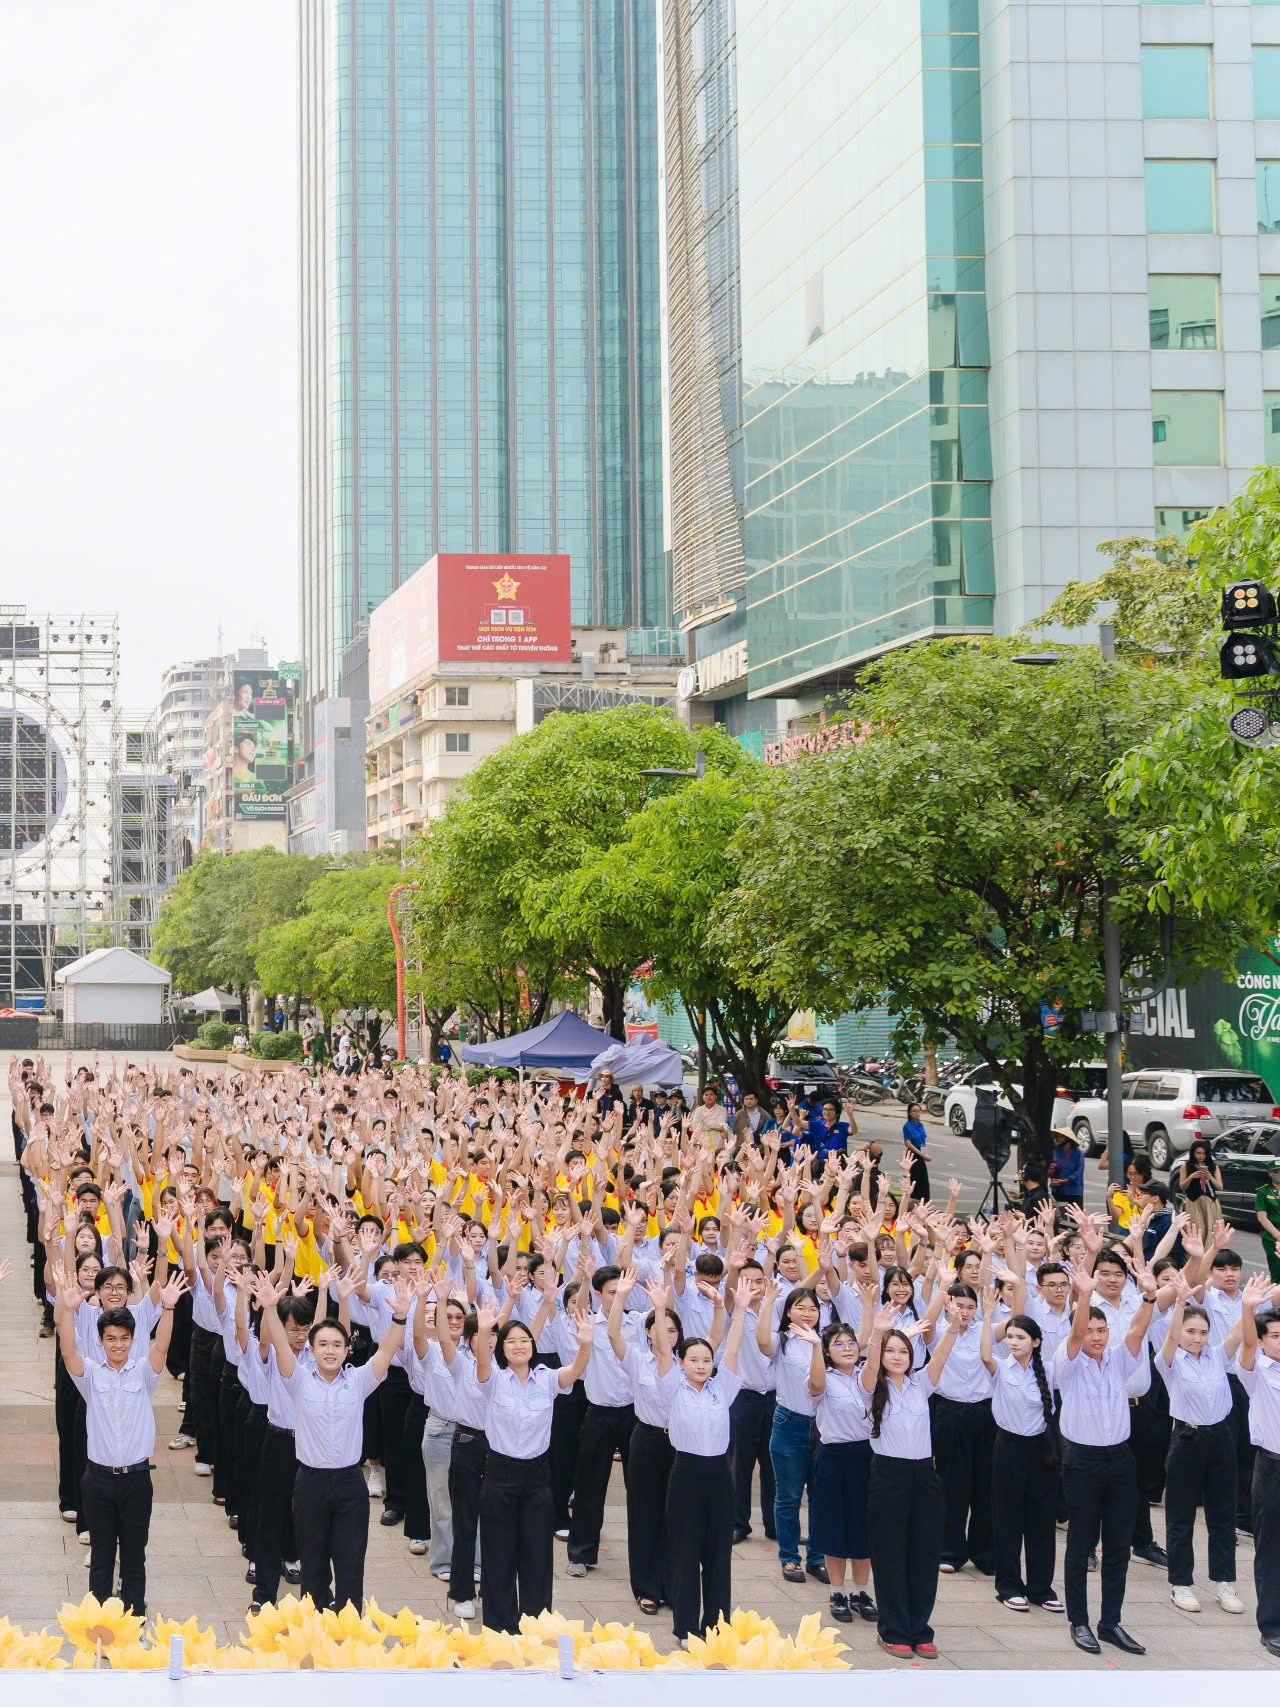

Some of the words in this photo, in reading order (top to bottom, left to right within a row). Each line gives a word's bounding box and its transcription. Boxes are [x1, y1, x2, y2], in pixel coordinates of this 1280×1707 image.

[477, 634, 490, 643] CHỈ
[242, 792, 260, 802] ĐẤU
[261, 793, 282, 802] ĐƠN
[1237, 971, 1271, 989] CÔNG
